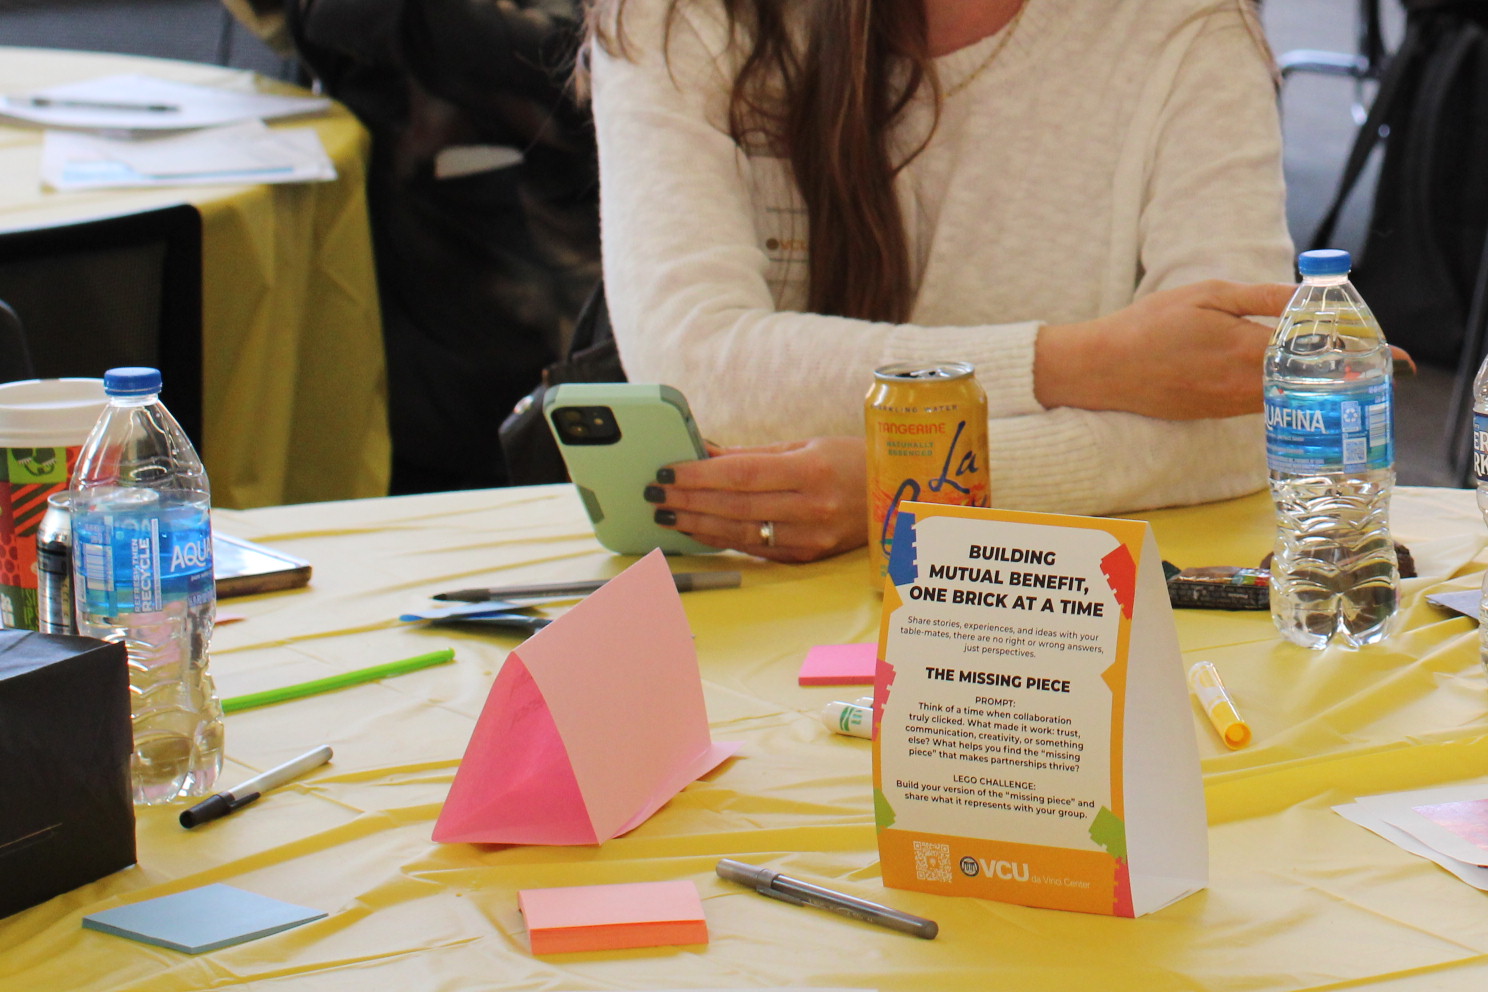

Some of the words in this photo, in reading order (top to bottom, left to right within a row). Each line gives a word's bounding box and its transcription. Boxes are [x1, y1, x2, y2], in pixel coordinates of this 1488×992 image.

[878, 421, 947, 436] TANGERINE
[928, 419, 979, 495] La
[969, 544, 1057, 566] BUILDING
[138, 537, 153, 613] RECYCLE
[929, 564, 1004, 585] MUTUAL
[1009, 571, 1090, 596] BENEFIT,
[909, 585, 948, 603] ONE
[952, 589, 1008, 609] BRICK
[1012, 595, 1037, 611] AT
[1040, 598, 1055, 613] A
[1060, 599, 1105, 618] TIME
[900, 627, 951, 640] table-mates,
[953, 632, 976, 641] there
[977, 634, 991, 643] are
[992, 636, 1004, 644] no
[1005, 637, 1025, 646] right
[1038, 641, 1066, 651] wrong
[1067, 643, 1104, 655] answers,
[907, 615, 931, 626] Share
[933, 618, 962, 630] stories,
[963, 621, 1016, 635] experiences,
[1017, 627, 1033, 635] and
[1035, 628, 1057, 638] ideas
[1059, 630, 1078, 640] with
[1079, 633, 1099, 642] your
[963, 643, 980, 653] just
[981, 645, 1036, 658] perspectives.
[926, 666, 955, 682] THE
[959, 670, 1022, 689] MISSING
[1026, 677, 1071, 693] PIECE
[918, 701, 943, 712] Think
[945, 705, 955, 713] of
[963, 706, 984, 716] time
[986, 710, 1011, 719] when
[1013, 712, 1072, 726] collaboration
[975, 696, 1016, 708] PROMPT:
[905, 724, 977, 740] communication,
[978, 731, 1022, 745] creativity,
[1024, 736, 1034, 744] or
[1035, 739, 1084, 751] something
[909, 712, 930, 724] truly
[931, 715, 965, 726] clicked.
[967, 718, 992, 729] What
[993, 721, 1019, 732] made
[1021, 723, 1028, 732] it
[1030, 726, 1055, 735] work:
[1056, 728, 1081, 739] trust,
[908, 735, 930, 746] else?
[932, 738, 957, 749] What
[958, 740, 984, 752] helps
[985, 745, 1001, 754] you
[1003, 744, 1022, 755] find
[1024, 747, 1039, 757] the
[939, 750, 958, 760] that
[960, 753, 989, 763] makes
[991, 756, 1047, 770] partnerships
[1049, 760, 1080, 772] thrive?
[896, 779, 919, 789] Build
[921, 783, 941, 792] your
[943, 786, 975, 796] version
[977, 789, 987, 797] of
[989, 789, 1004, 798] the
[1077, 800, 1095, 808] and
[953, 774, 978, 785] LEGO
[979, 776, 1037, 791] CHALLENGE:
[904, 792, 929, 802] share
[931, 795, 954, 805] what
[955, 796, 962, 805] it
[964, 798, 1012, 811] represents
[1013, 803, 1034, 812] with
[1035, 807, 1056, 816] your
[1058, 809, 1088, 820] group.
[979, 858, 1030, 882] VCU
